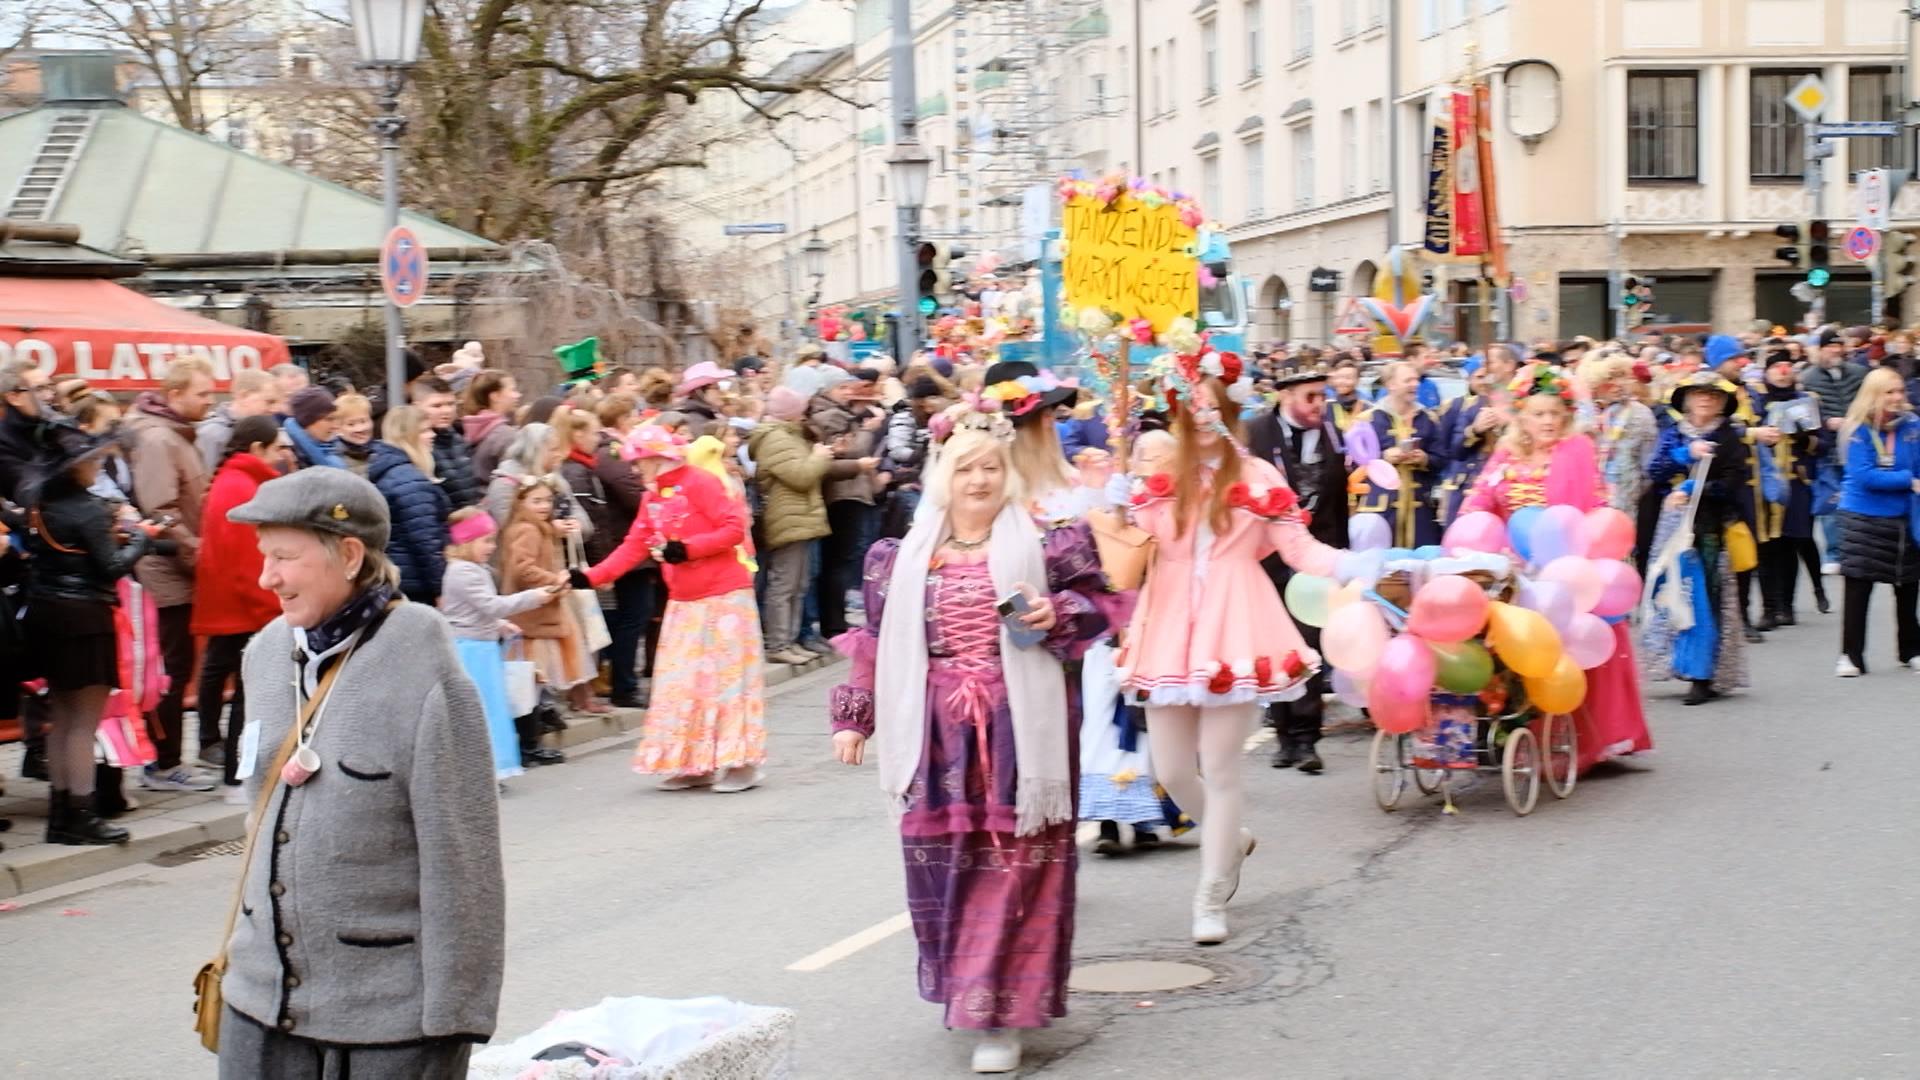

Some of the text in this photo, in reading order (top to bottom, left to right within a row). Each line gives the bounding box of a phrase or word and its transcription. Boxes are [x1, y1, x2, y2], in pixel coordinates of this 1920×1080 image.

[1065, 204, 1188, 254] TANZENDE
[0, 339, 261, 381] O LATNO
